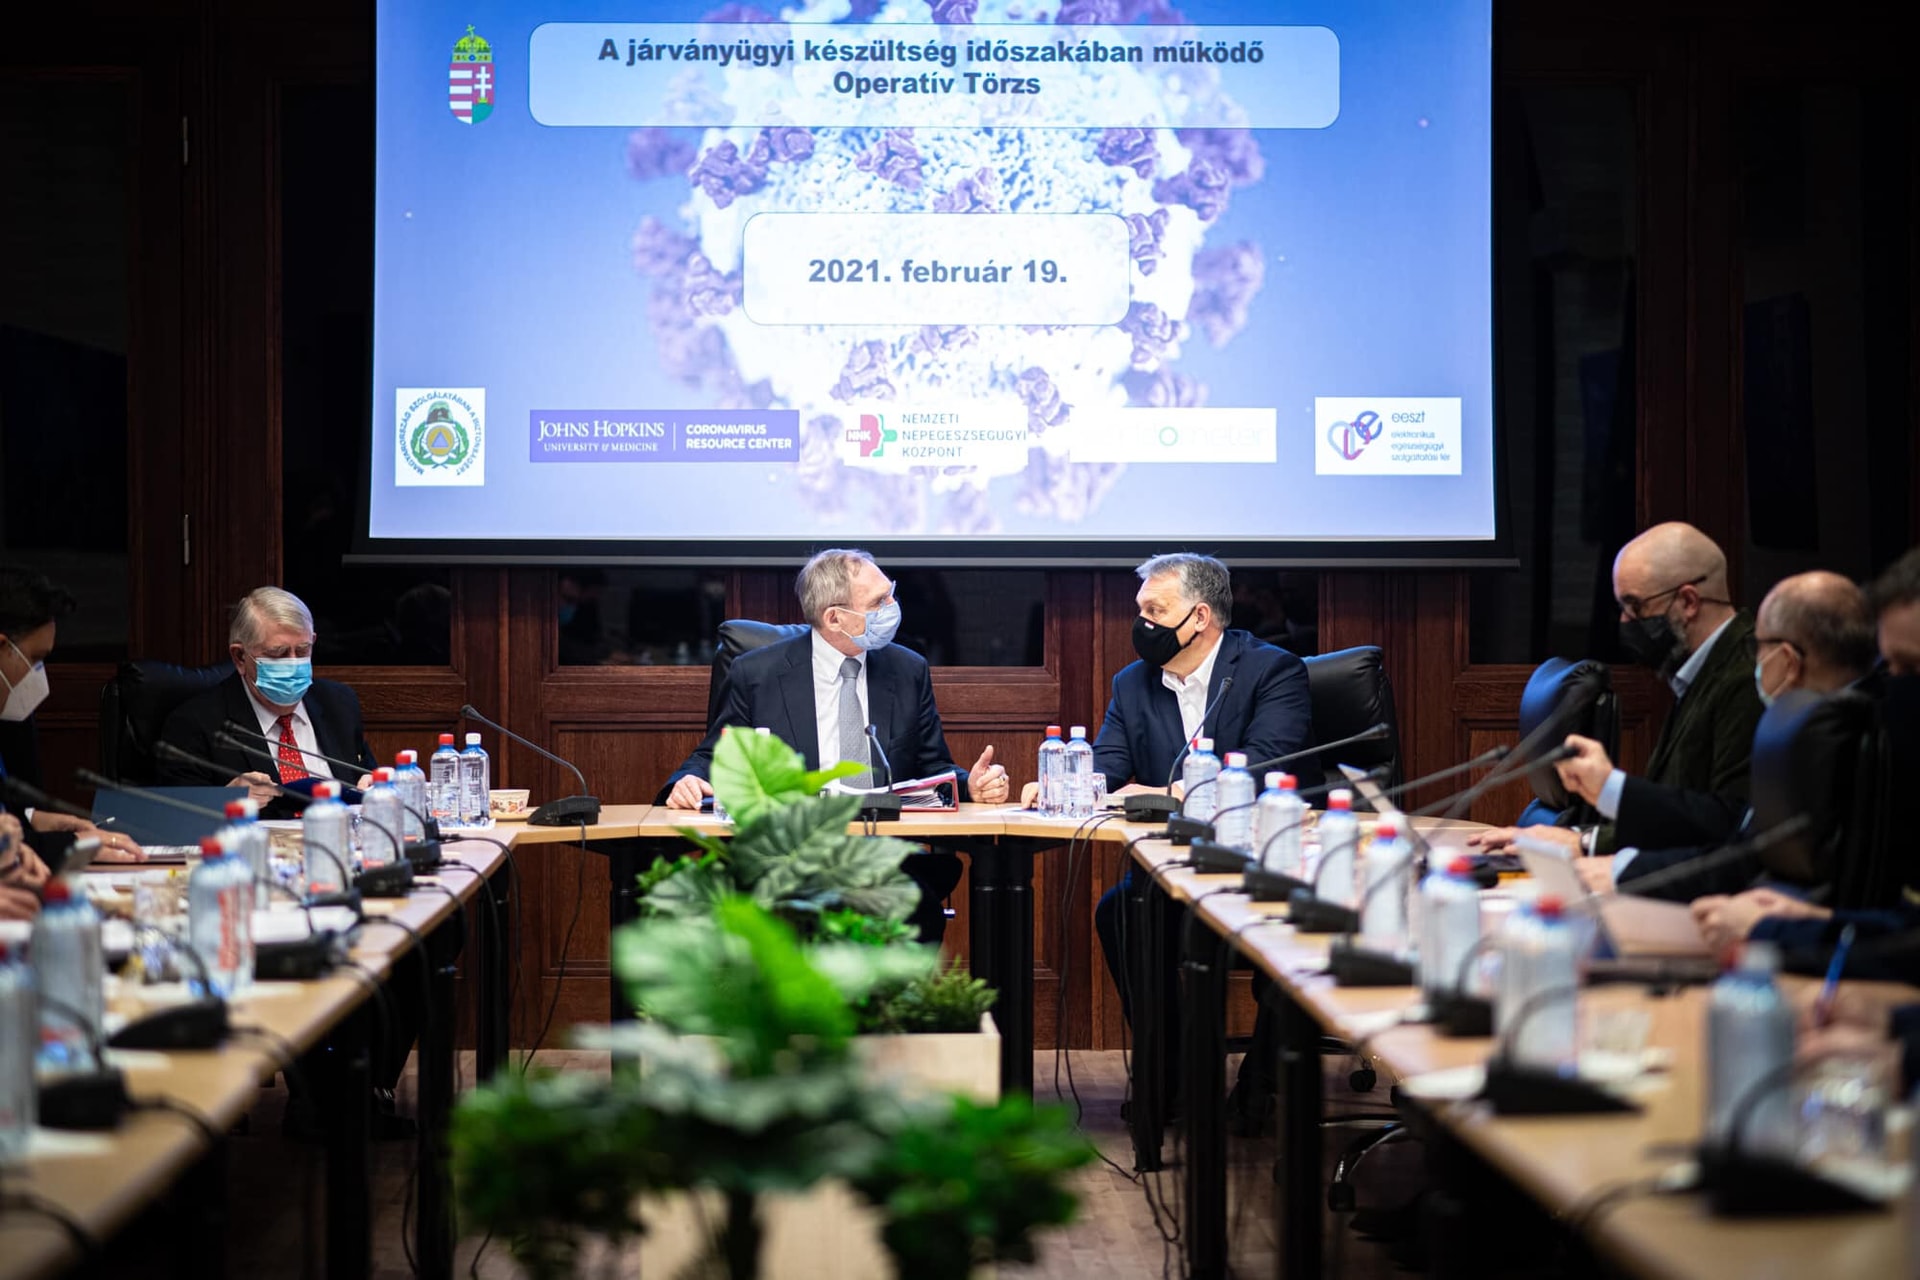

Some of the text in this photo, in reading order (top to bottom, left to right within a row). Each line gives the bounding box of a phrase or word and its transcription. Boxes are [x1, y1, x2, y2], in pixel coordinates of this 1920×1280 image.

[597, 37, 1265, 68] A járványügyi készültség időszakában működő
[833, 71, 1041, 98] Operatív Törzs
[809, 259, 1067, 283] 2021. február 19.
[902, 413, 960, 424] NEMZETI
[1391, 410, 1425, 424] eeszt
[538, 420, 665, 441] JOHNS HOPKINS
[686, 423, 767, 435] CORONAVIRUS
[543, 443, 599, 452] UNIVERSITY
[611, 443, 658, 452] MEDICINE
[686, 437, 792, 449] RESOURCE CENTER
